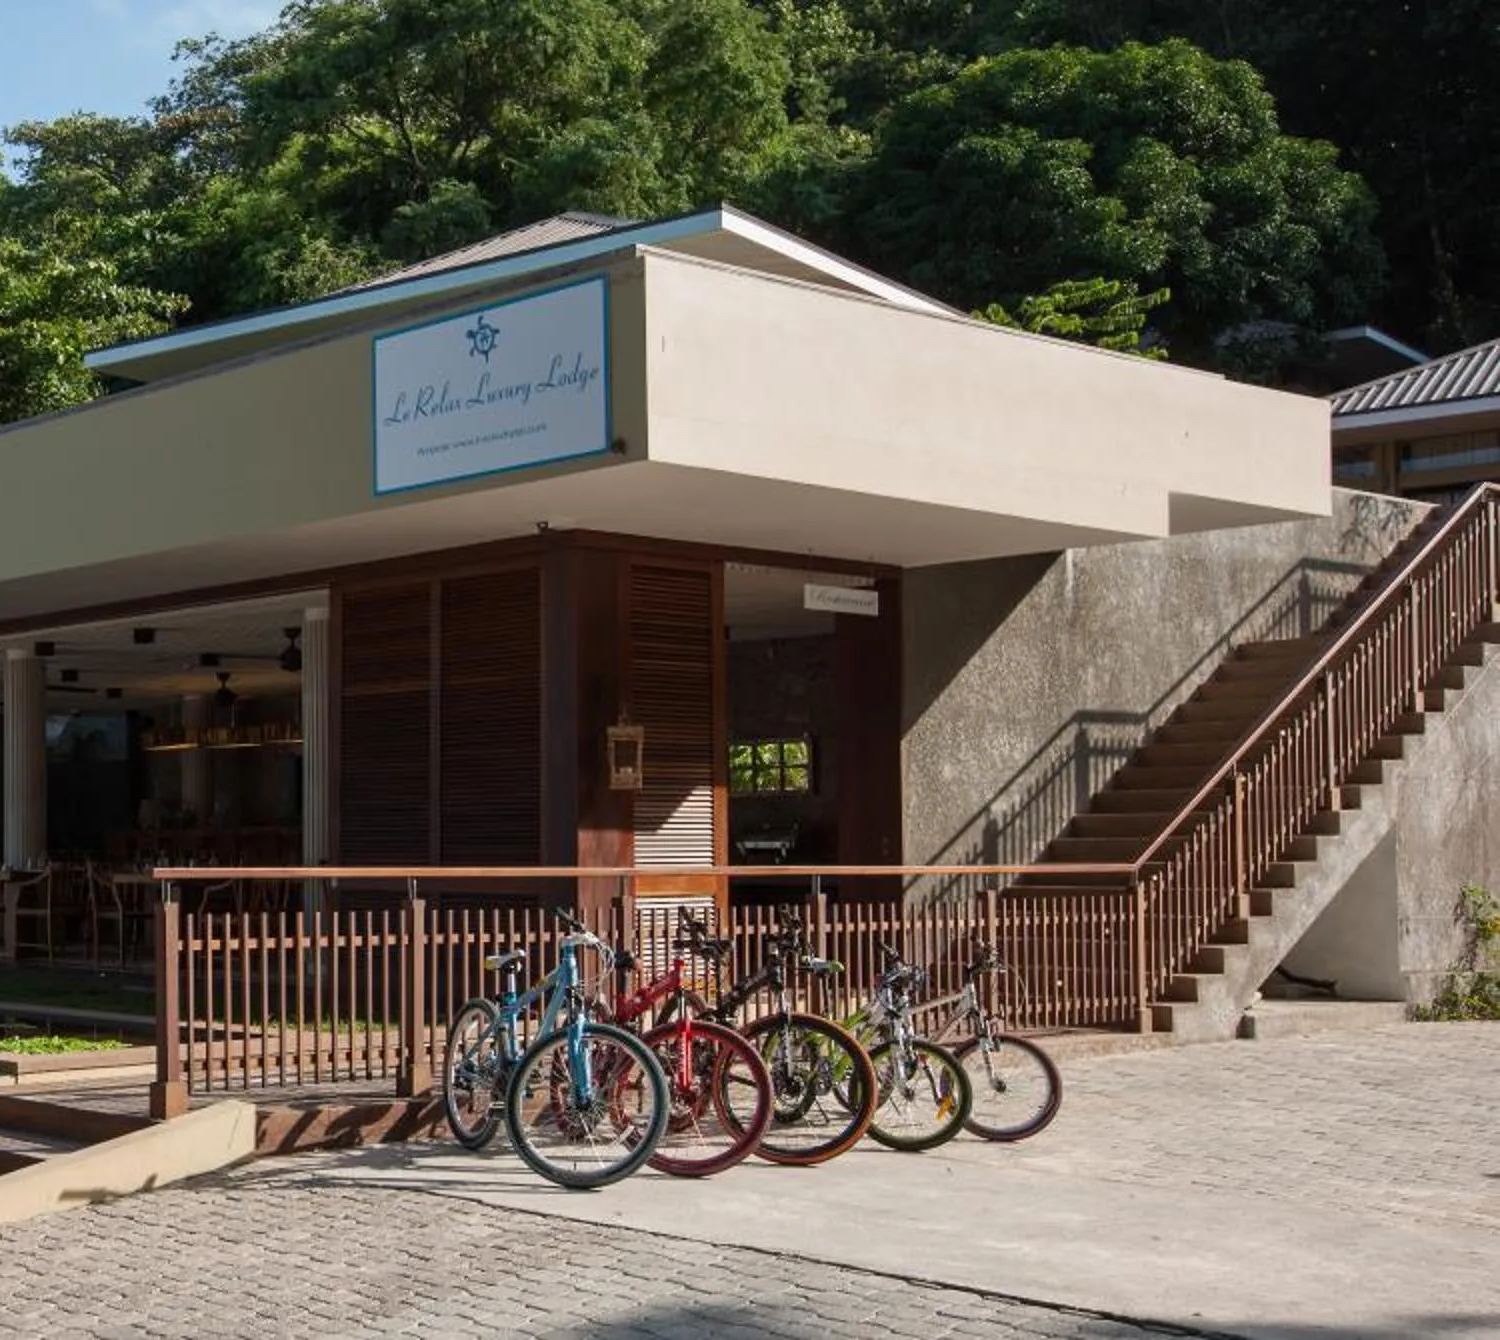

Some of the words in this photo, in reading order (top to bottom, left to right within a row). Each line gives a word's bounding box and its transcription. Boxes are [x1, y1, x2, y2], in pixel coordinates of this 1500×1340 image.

[385, 392, 410, 424] Le
[413, 380, 462, 421] Relax
[466, 372, 532, 406] Luxury
[537, 353, 599, 391] Lodge
